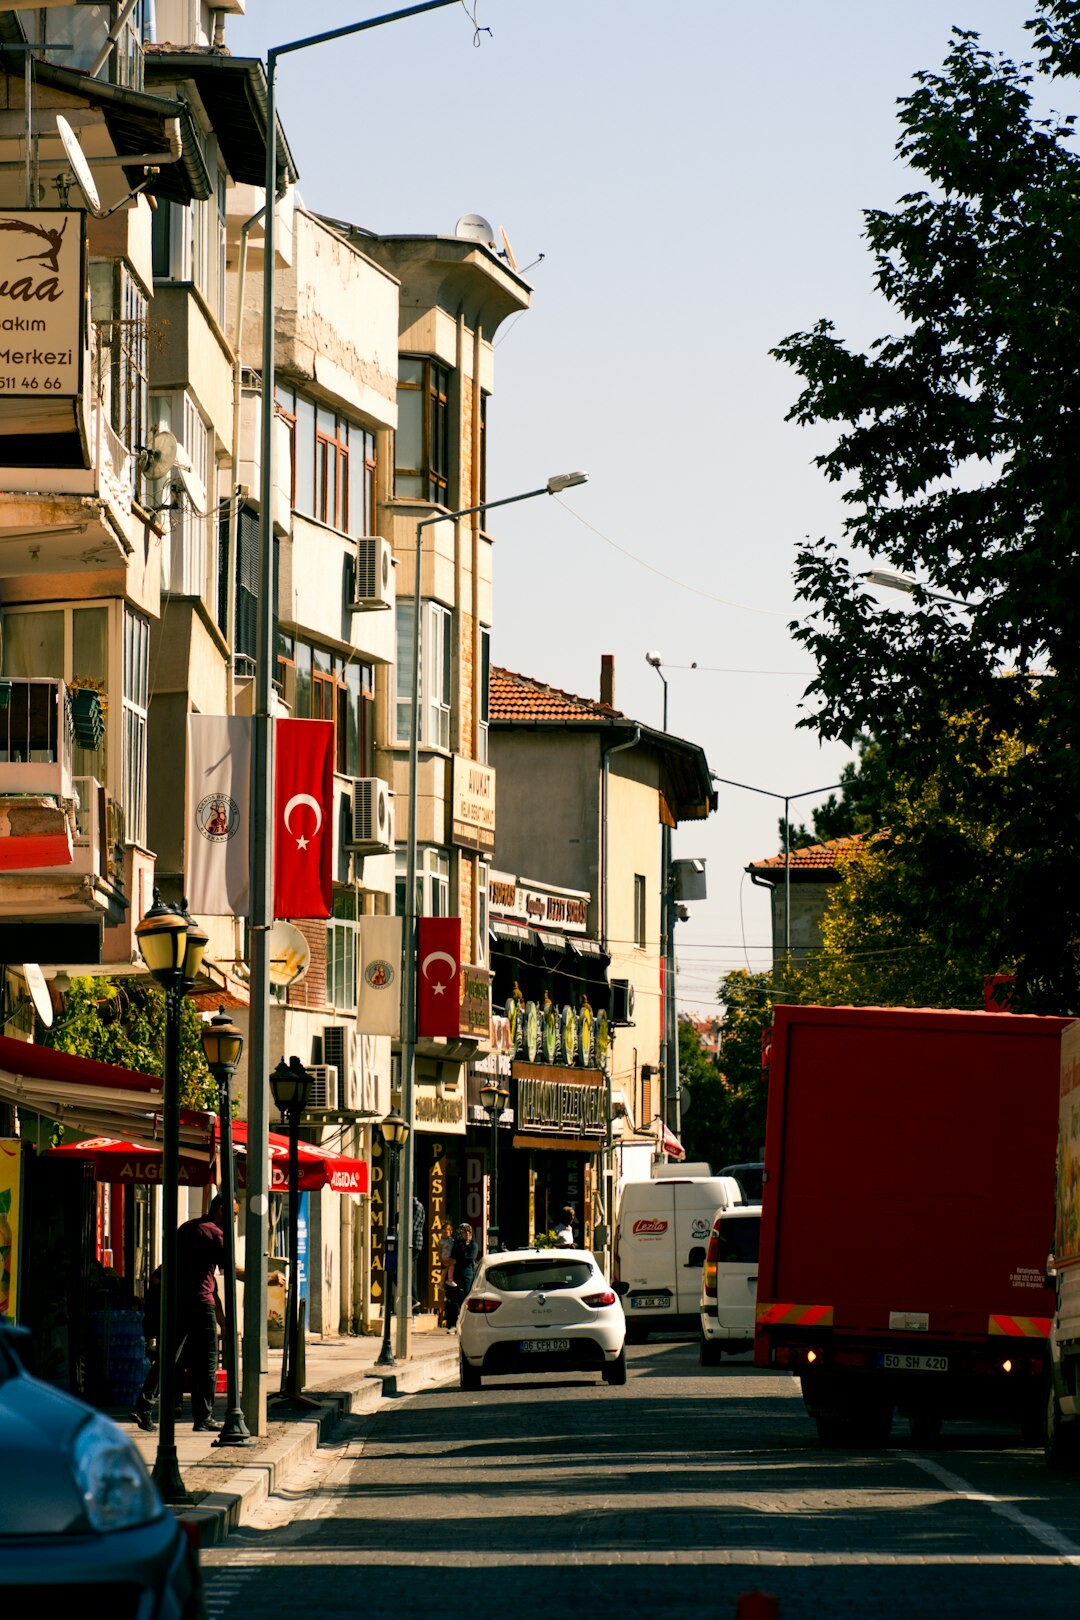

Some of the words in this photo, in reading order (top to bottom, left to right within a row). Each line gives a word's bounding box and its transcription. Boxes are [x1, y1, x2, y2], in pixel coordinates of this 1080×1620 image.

[0, 317, 46, 331] akım
[0, 349, 72, 365] Merkezi
[21, 377, 39, 389] 46
[44, 377, 61, 389] 66
[469, 768, 490, 799] AVUKAT
[371, 1167, 384, 1271] DAMLA
[636, 1219, 665, 1232] Lezita
[885, 1355, 900, 1367] 50
[905, 1356, 920, 1368] SH
[925, 1357, 947, 1369] 420
